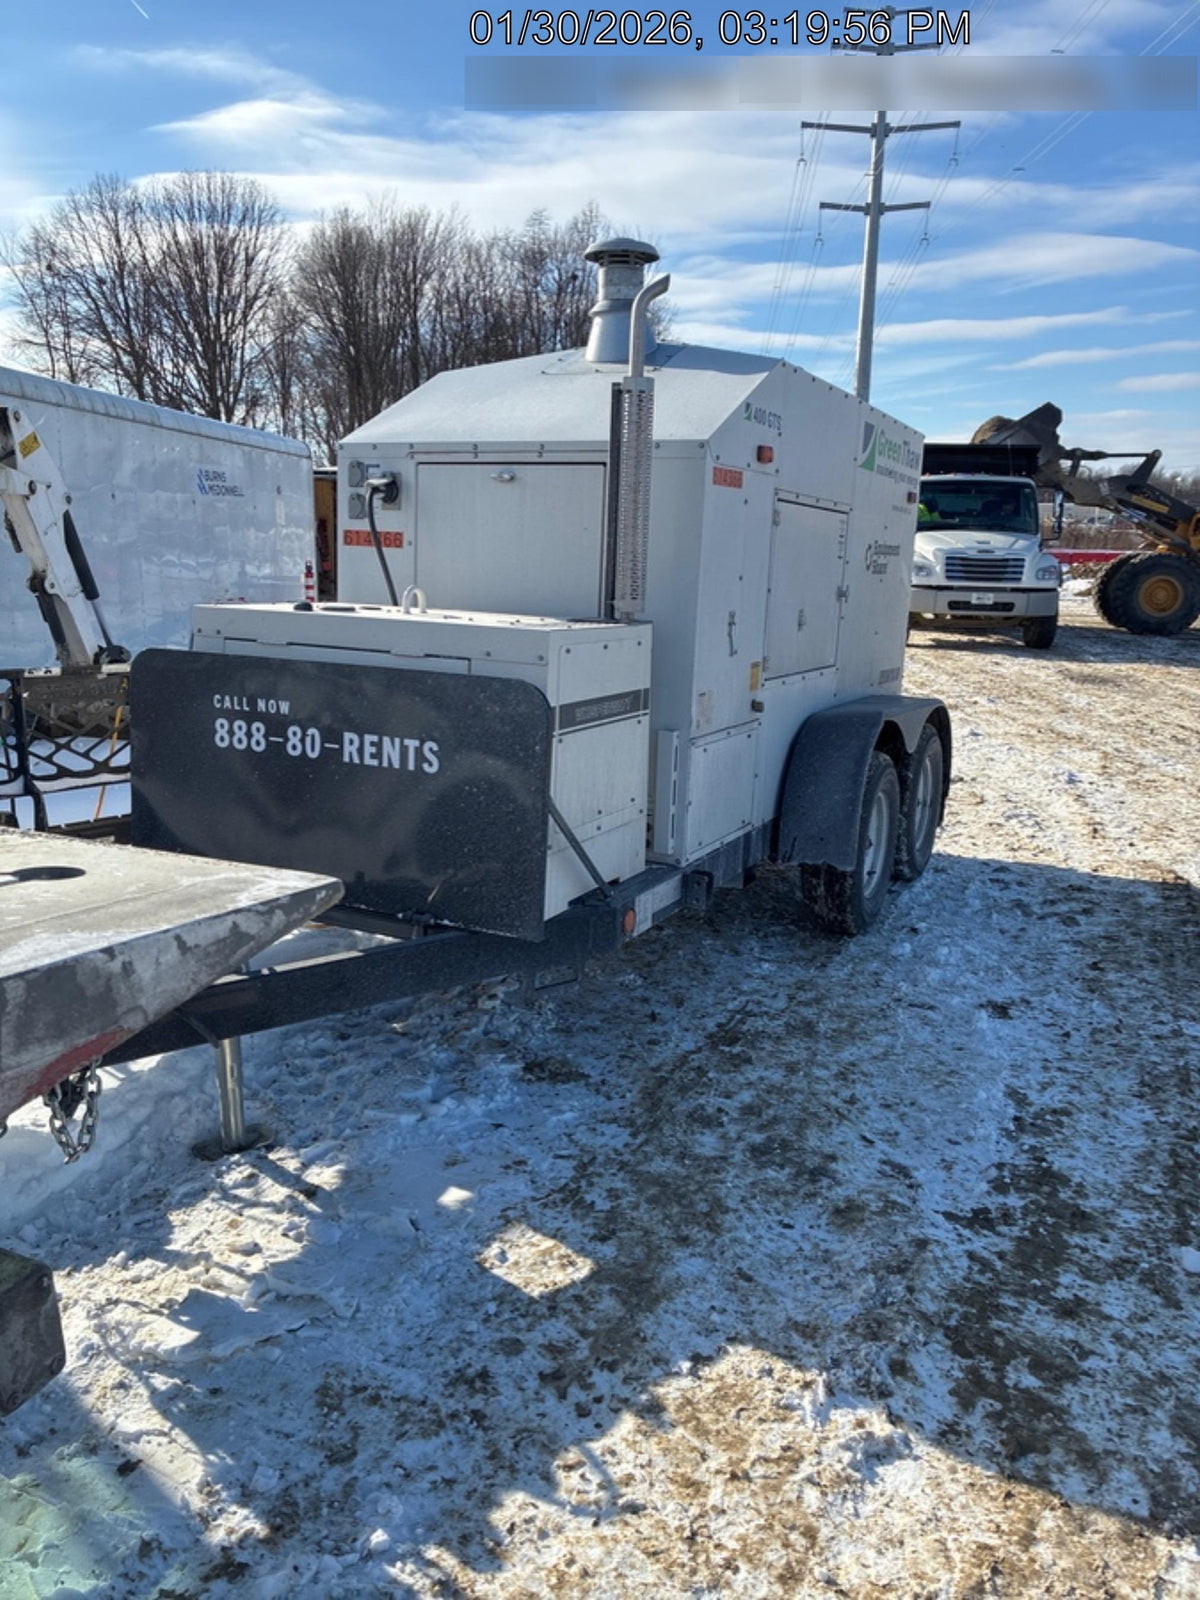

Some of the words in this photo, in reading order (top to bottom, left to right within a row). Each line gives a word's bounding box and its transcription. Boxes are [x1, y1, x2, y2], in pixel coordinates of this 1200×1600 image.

[204, 470, 226, 483] BURNS
[344, 530, 403, 548] 61466
[214, 694, 250, 712] CALL
[256, 698, 291, 715] NOW
[214, 717, 440, 775] 888-80-RENTS
